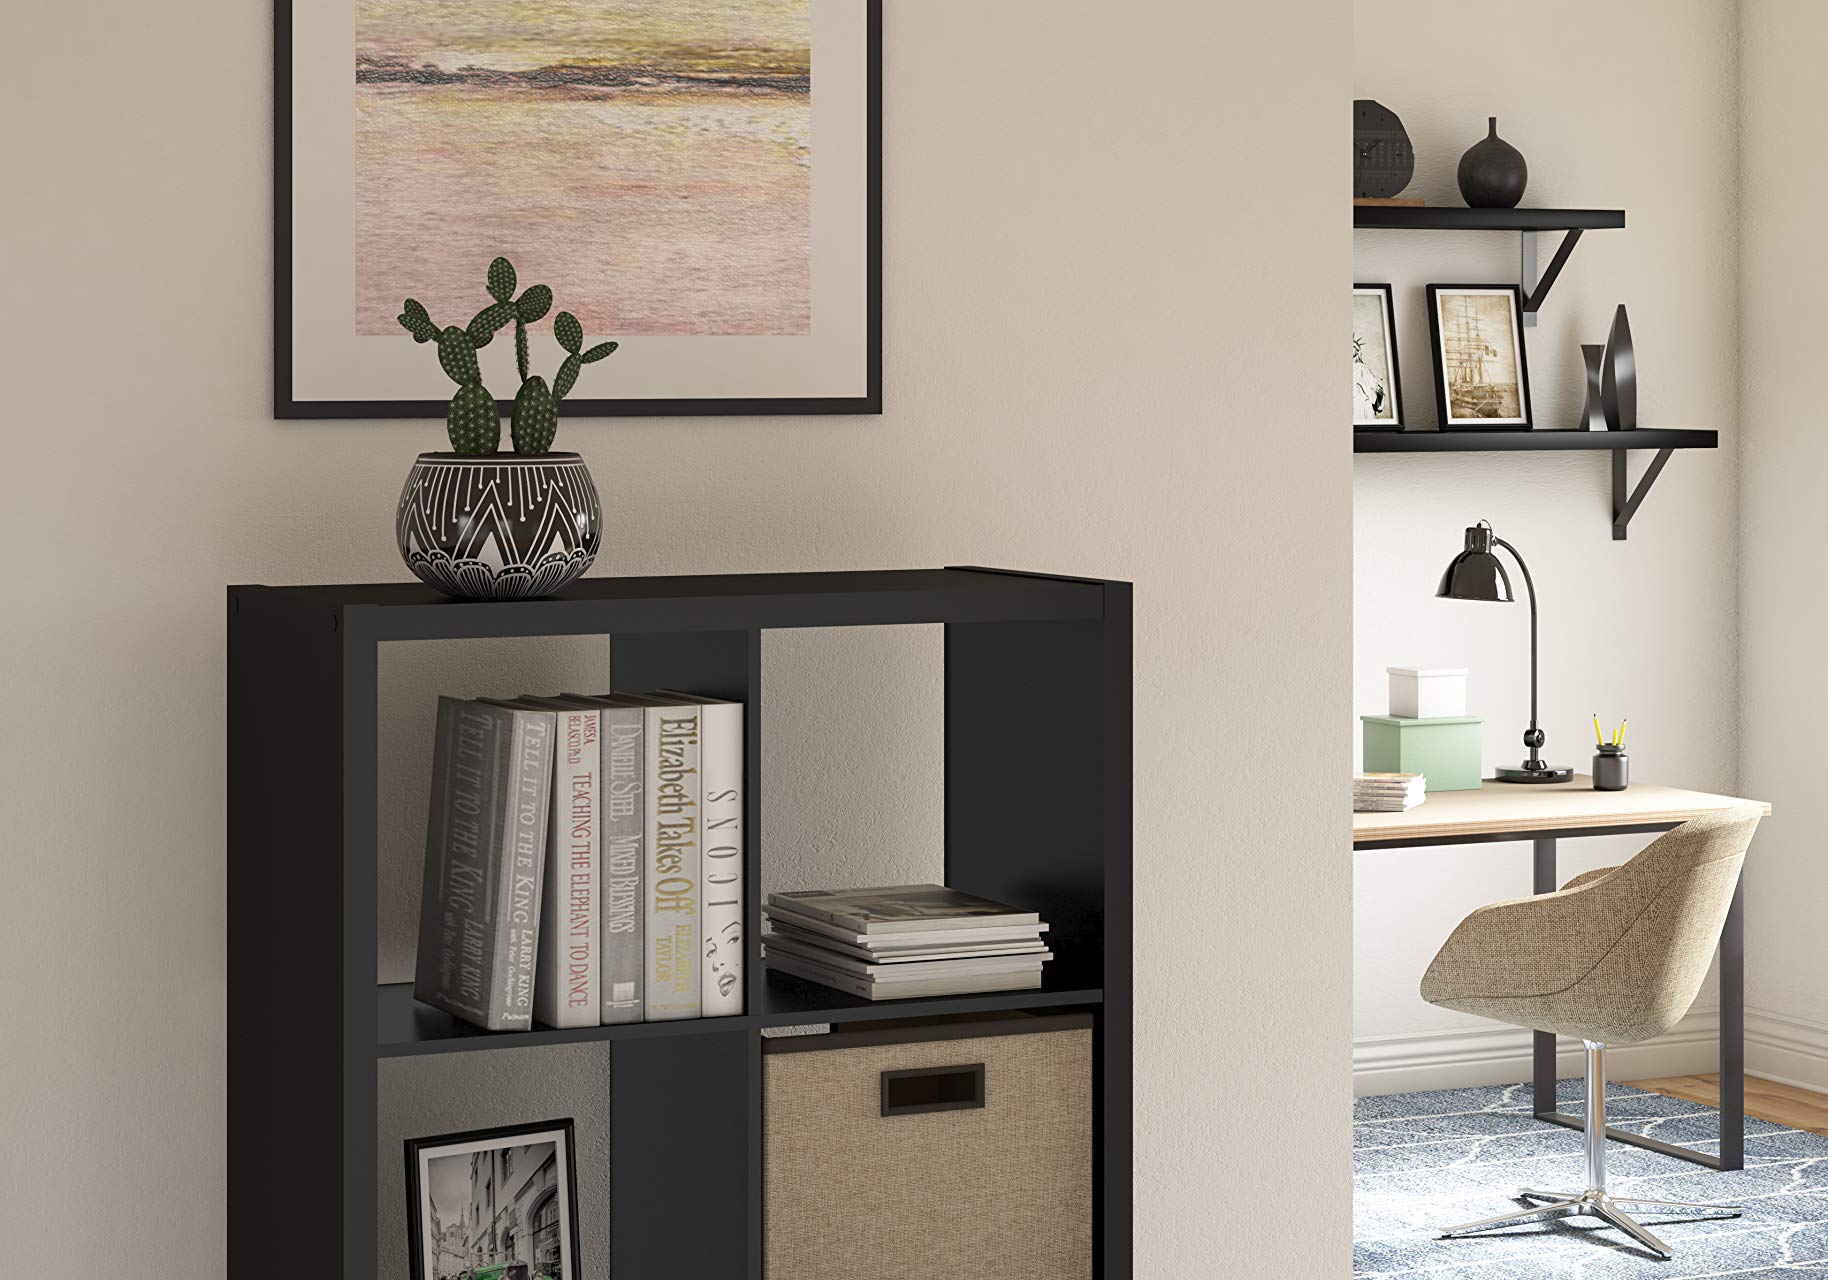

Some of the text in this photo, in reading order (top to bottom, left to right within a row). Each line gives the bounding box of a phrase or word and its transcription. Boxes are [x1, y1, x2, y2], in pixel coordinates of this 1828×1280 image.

[457, 711, 493, 760] TELL
[583, 715, 597, 738] JAMES
[455, 763, 481, 788] IT
[609, 724, 642, 822] DANIELLE STEEL
[455, 788, 481, 815] TO
[511, 721, 547, 924] TELL IT TO THE KING
[655, 715, 698, 916] Elizabeth Takes Off
[450, 818, 481, 858] THE
[706, 789, 739, 909] ICONS
[448, 859, 483, 912] KING
[568, 772, 592, 1008] TEACHING THE ELEPHANT TO DANCE
[608, 832, 642, 933] MIXED BLESSINGS
[461, 918, 485, 964] LARRY
[655, 935, 673, 983] TAYLOR
[459, 963, 481, 1001] KING
[516, 928, 534, 1007] LARRY KING
